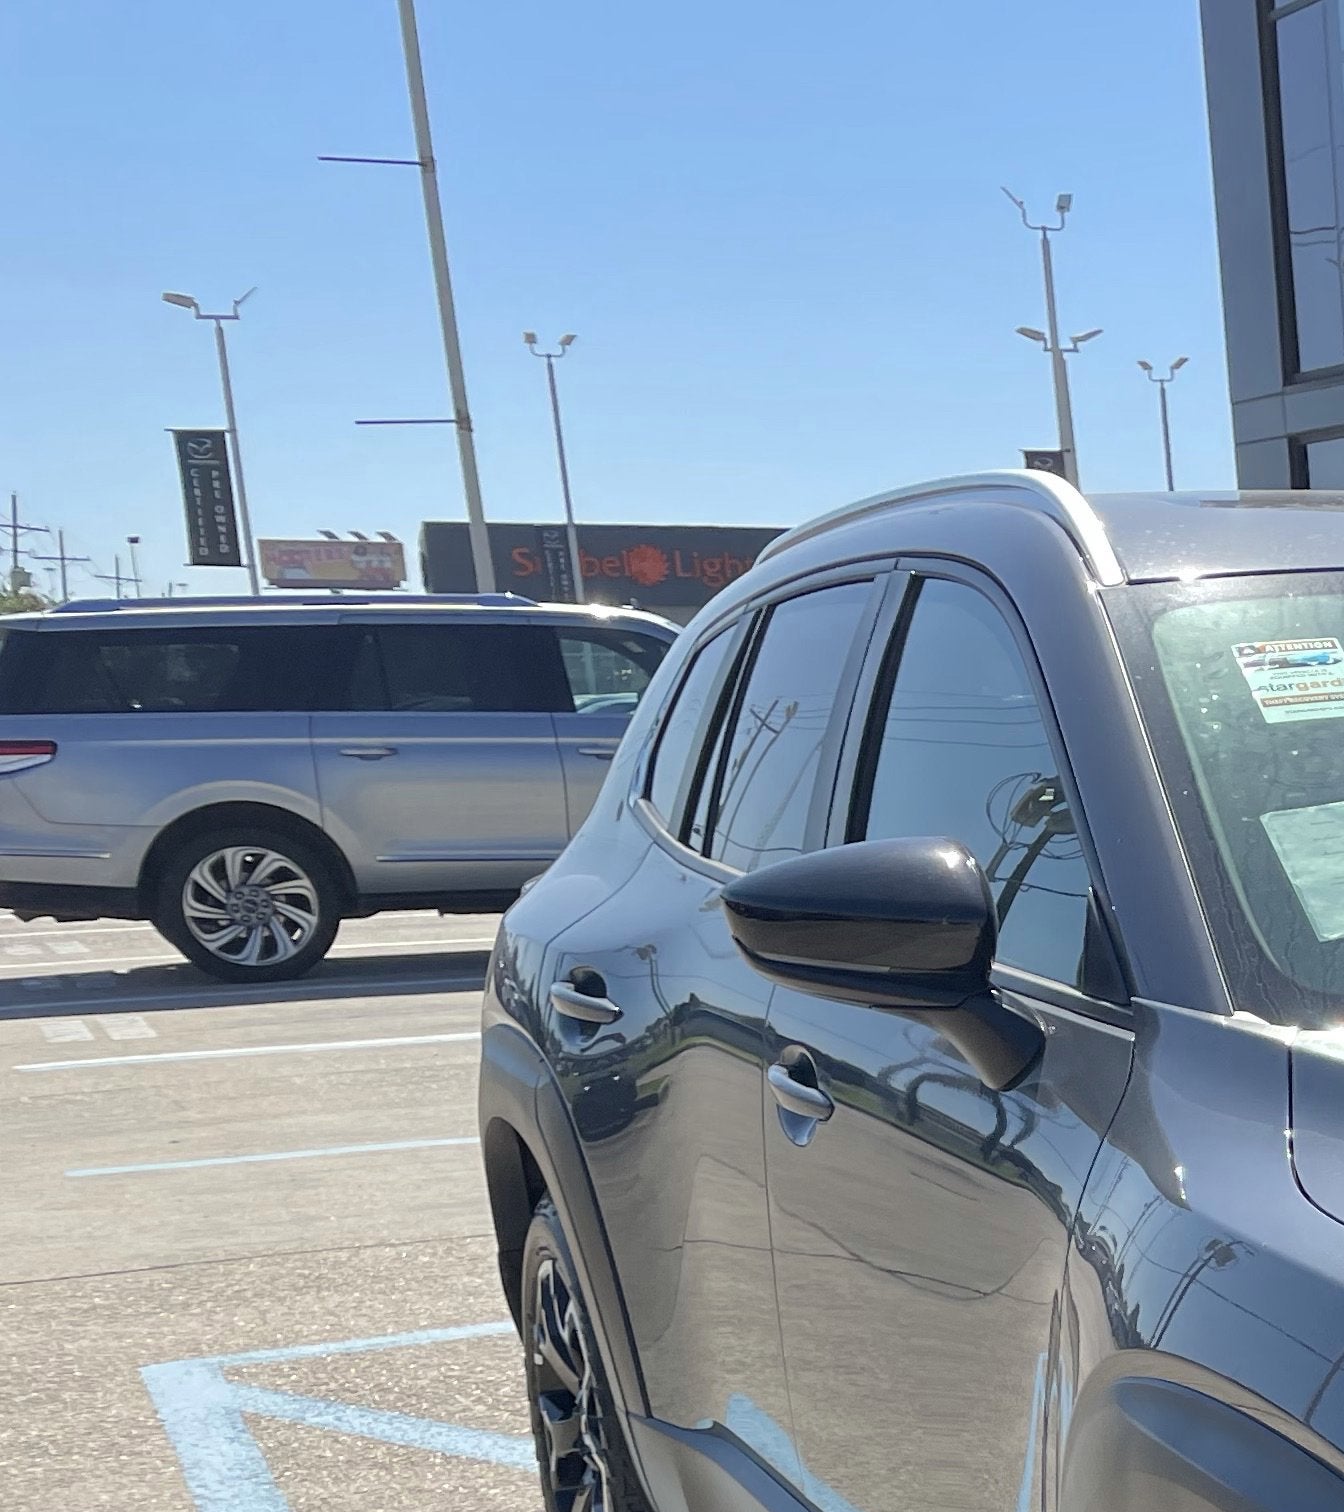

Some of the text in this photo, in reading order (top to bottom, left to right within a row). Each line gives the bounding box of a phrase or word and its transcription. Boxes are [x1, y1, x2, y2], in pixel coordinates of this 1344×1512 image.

[190, 468, 209, 556] CERTIFIED
[211, 469, 230, 553] PRE OWNED
[673, 549, 754, 588] Ligh
[1264, 640, 1334, 653] ATTENTION
